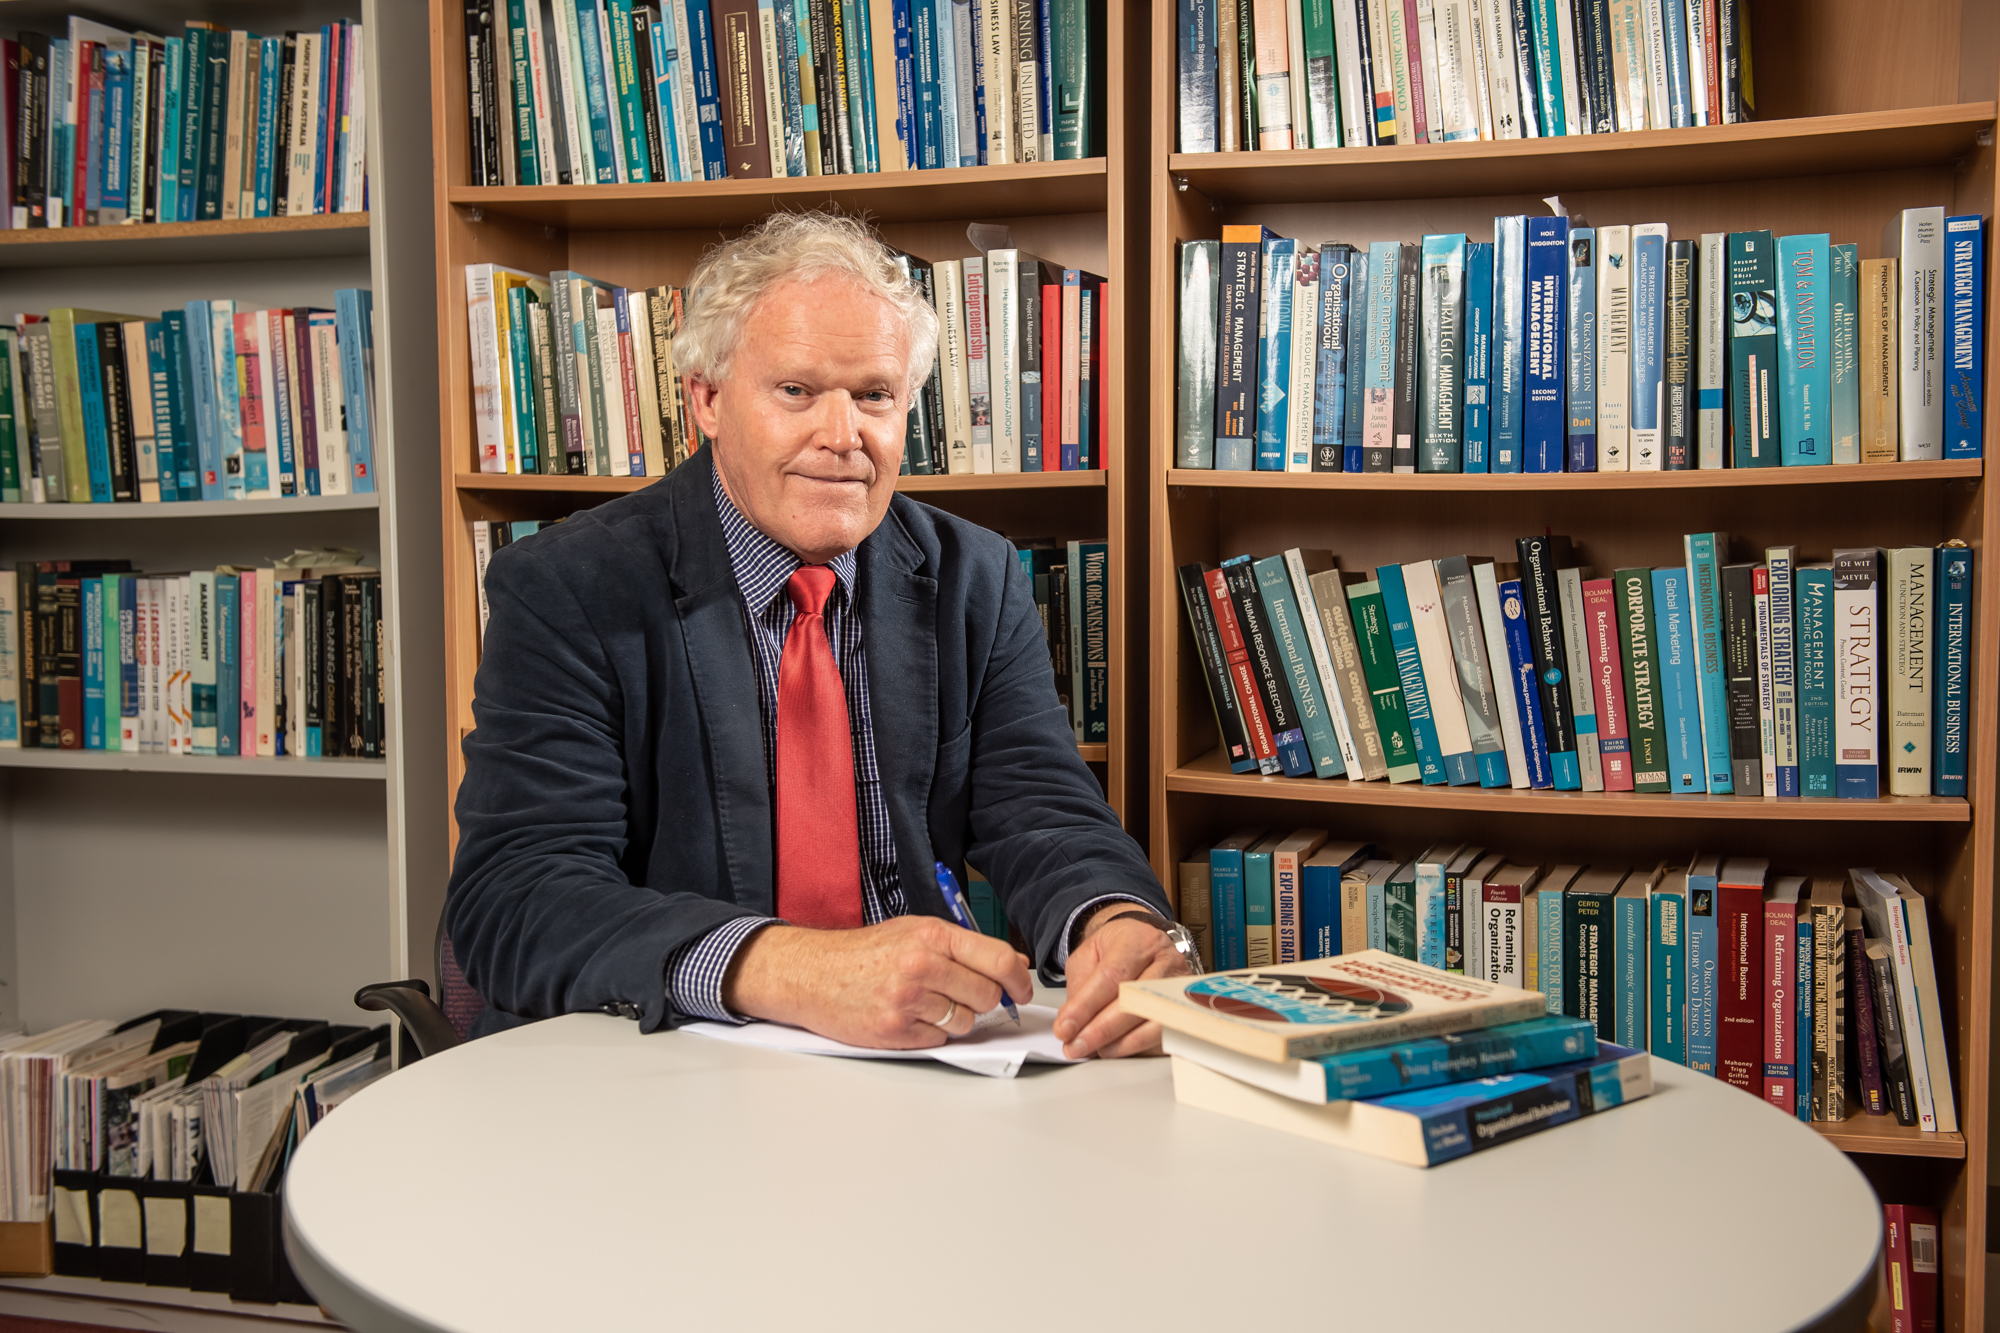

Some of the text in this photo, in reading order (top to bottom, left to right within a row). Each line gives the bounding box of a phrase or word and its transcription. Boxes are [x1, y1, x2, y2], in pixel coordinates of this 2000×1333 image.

[991, 37, 1000, 56] LAW
[1197, 6, 1205, 41] Corporate
[302, 38, 312, 87] MARKETING
[512, 27, 531, 142] MODERN COMPETITIVE ANALYSIS
[531, 31, 545, 120] Strategic Management
[737, 31, 750, 127] STRATEGIC MANAGEMENT
[834, 27, 848, 112] CORPORATE STRATEGY
[1392, 10, 1408, 112] COMMUNICATION
[1450, 45, 1458, 83] CORPORATE
[1653, 29, 1664, 87] MANAGEMENT
[184, 31, 199, 161] organizational behavior
[299, 101, 309, 147] AUSTRALIA
[1019, 64, 1035, 140] UNLIMITED
[630, 137, 639, 161] BENNETT
[689, 134, 698, 161] Heyne
[967, 272, 983, 360] Entrepreneurship
[1232, 251, 1247, 383] STRATEGIC MANAGEMENT
[1330, 263, 1348, 350] Organisational
[1378, 251, 1396, 382] strategic management
[1925, 269, 1938, 304] Strategic
[1954, 240, 1973, 370] STRATEGIC MANAGEMENT
[945, 302, 959, 368] BUSINESS LAW
[1002, 303, 1011, 358] MANAGEMENT
[1026, 298, 1034, 361] Project Management
[1322, 290, 1333, 350] BEHAVIOUR
[1529, 281, 1542, 376] MANAGEMENT
[1542, 275, 1554, 380] INTERNATIONAL
[1583, 311, 1594, 392] ORGANIZATION
[1611, 287, 1628, 354] MANAGEMENT
[1647, 306, 1655, 355] MANAGEMENT
[1882, 319, 1888, 332] OF
[1925, 306, 1937, 361] Management
[30, 335, 45, 410] MANAGEMENT
[39, 334, 55, 409] STRATEGIC
[243, 339, 258, 427] management
[1301, 292, 1314, 448] HUMAN RESOURCE MANAGEMENT
[1503, 340, 1512, 393] PRODUCTIVITY
[1639, 328, 1647, 383] STAKEHOLDERS
[1647, 356, 1654, 366] OF
[153, 372, 173, 453] MANAGEMENT
[1003, 372, 1012, 437] ORGANIZATIONS
[1572, 417, 1592, 427] Daft
[1584, 588, 1613, 597] BOLMAN
[1840, 560, 1871, 568] DE WIT
[1841, 573, 1870, 581] MEYER
[1951, 582, 1962, 590] Hill
[199, 582, 209, 662] MANAGEMENT
[1085, 551, 1105, 661] WORK ORGANISATIONS
[1664, 577, 1681, 666] Global Marketing
[1806, 582, 1827, 690] MANAGEMENT
[1898, 579, 1907, 677] FUNCTION AND STRATEGY
[1908, 562, 1926, 693] MANAGEMENT
[1597, 610, 1617, 735] Reframing Organizations
[1626, 576, 1655, 730] CORPORATE STRATEGY
[1803, 597, 1813, 690] A PACIFIC RIM FOCUS
[1849, 605, 1873, 733] STRATEGY
[1946, 602, 1963, 754] INTERNATIONAL BUSINESS
[1897, 766, 1923, 774] IRWIN
[1279, 871, 1294, 927] EXPLORING
[1447, 877, 1456, 911] CHANGE
[1577, 900, 1600, 908] CERTO
[1578, 908, 1599, 916] PETER
[1660, 899, 1669, 946] MANAGEMENT
[1764, 911, 1794, 920] BOLMAN
[1769, 919, 1788, 927] DEAL
[1502, 908, 1517, 974] Reframing
[1589, 924, 1599, 976] STRATEGIC
[1738, 912, 1750, 1001] International Business
[1703, 959, 1716, 1038] ORGANIZATION
[1774, 934, 1786, 1060] Reframing Organizations
[1724, 1059, 1753, 1068] Mahoney
[1728, 1078, 1750, 1086] Pustay
[1730, 1066, 1747, 1074] Trigg
